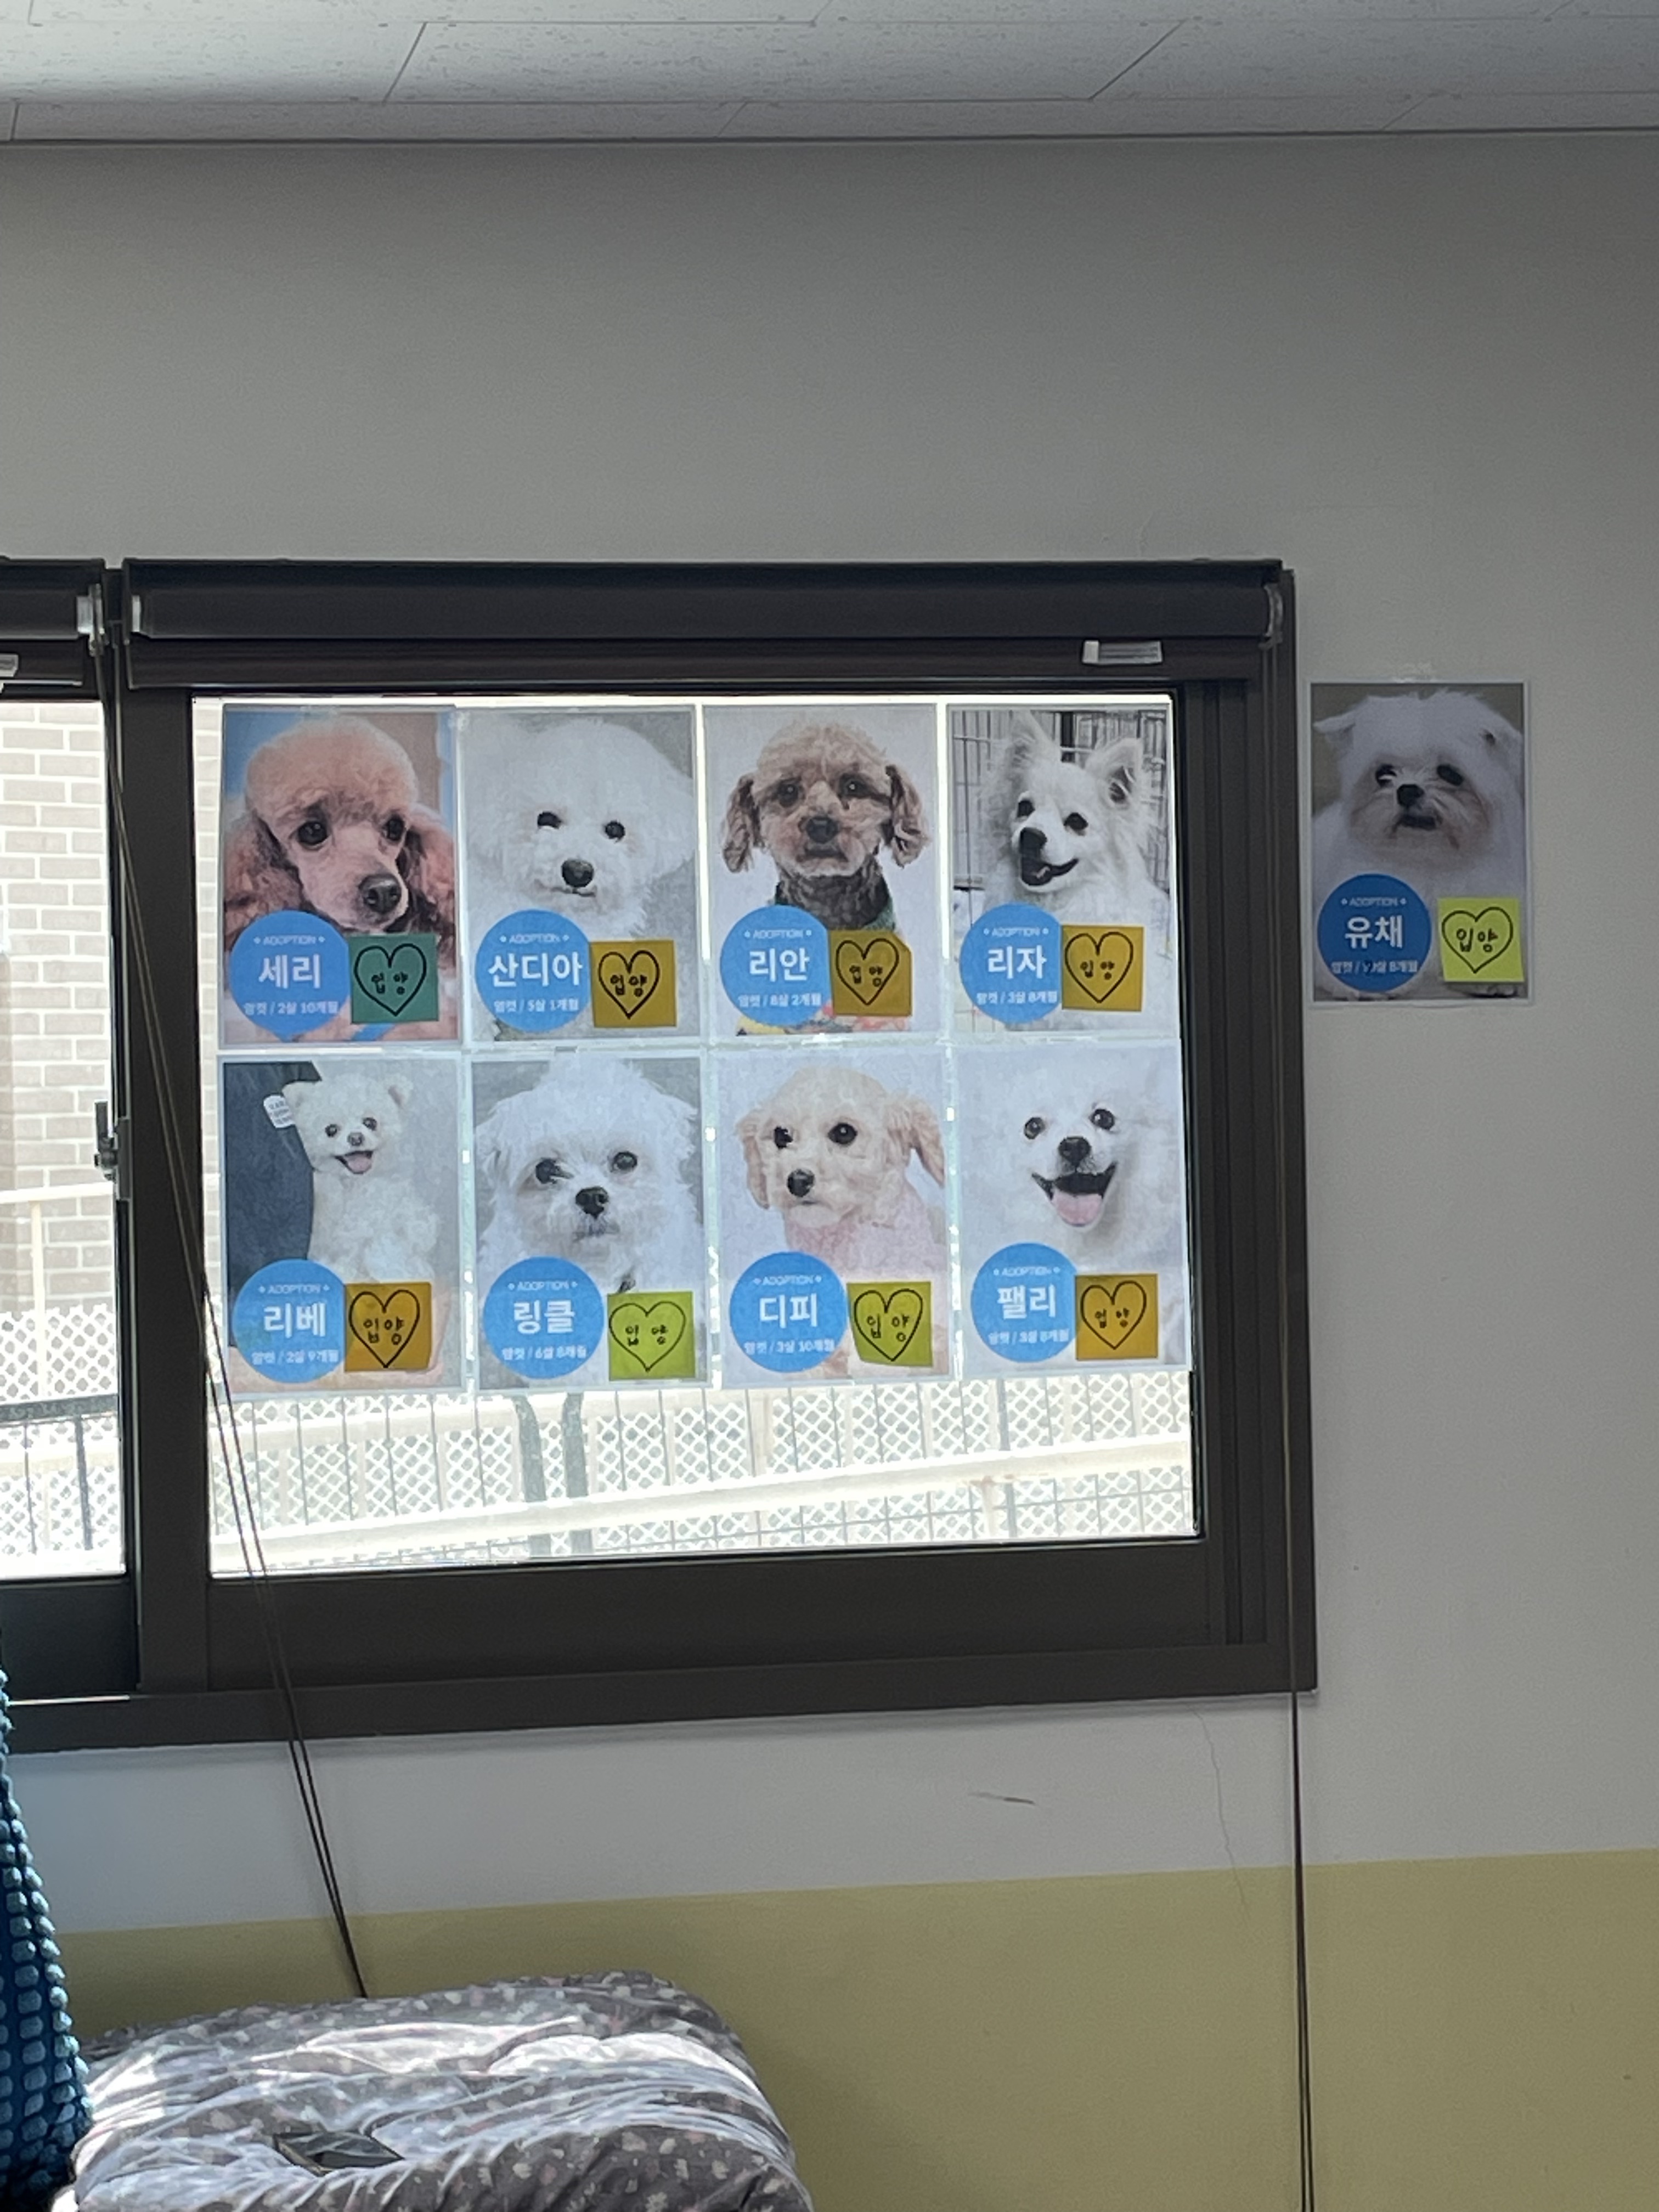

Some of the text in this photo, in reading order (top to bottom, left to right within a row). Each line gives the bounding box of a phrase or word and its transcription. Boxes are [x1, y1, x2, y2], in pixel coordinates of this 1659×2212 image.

[1349, 897, 1398, 907] ADOPTION
[263, 935, 317, 946] ADOPTION
[509, 934, 561, 944] ADOPTION
[753, 929, 804, 939] ADOPTION
[991, 928, 1041, 937] ADOPTION
[1344, 915, 1403, 949] 유채
[258, 953, 320, 989] 세리
[488, 951, 583, 987] 산디아
[749, 947, 810, 983] 리안
[988, 945, 1047, 979] 리자
[761, 1275, 814, 1285] ADOPTION
[1001, 1266, 1052, 1277] ADOPTION
[268, 1284, 321, 1294] ADOPTION
[517, 1280, 569, 1290] ADOPTION
[759, 1293, 817, 1329] 디피
[997, 1284, 1056, 1320] 팰리
[263, 1301, 326, 1339] 리베
[513, 1299, 575, 1335] 링클
